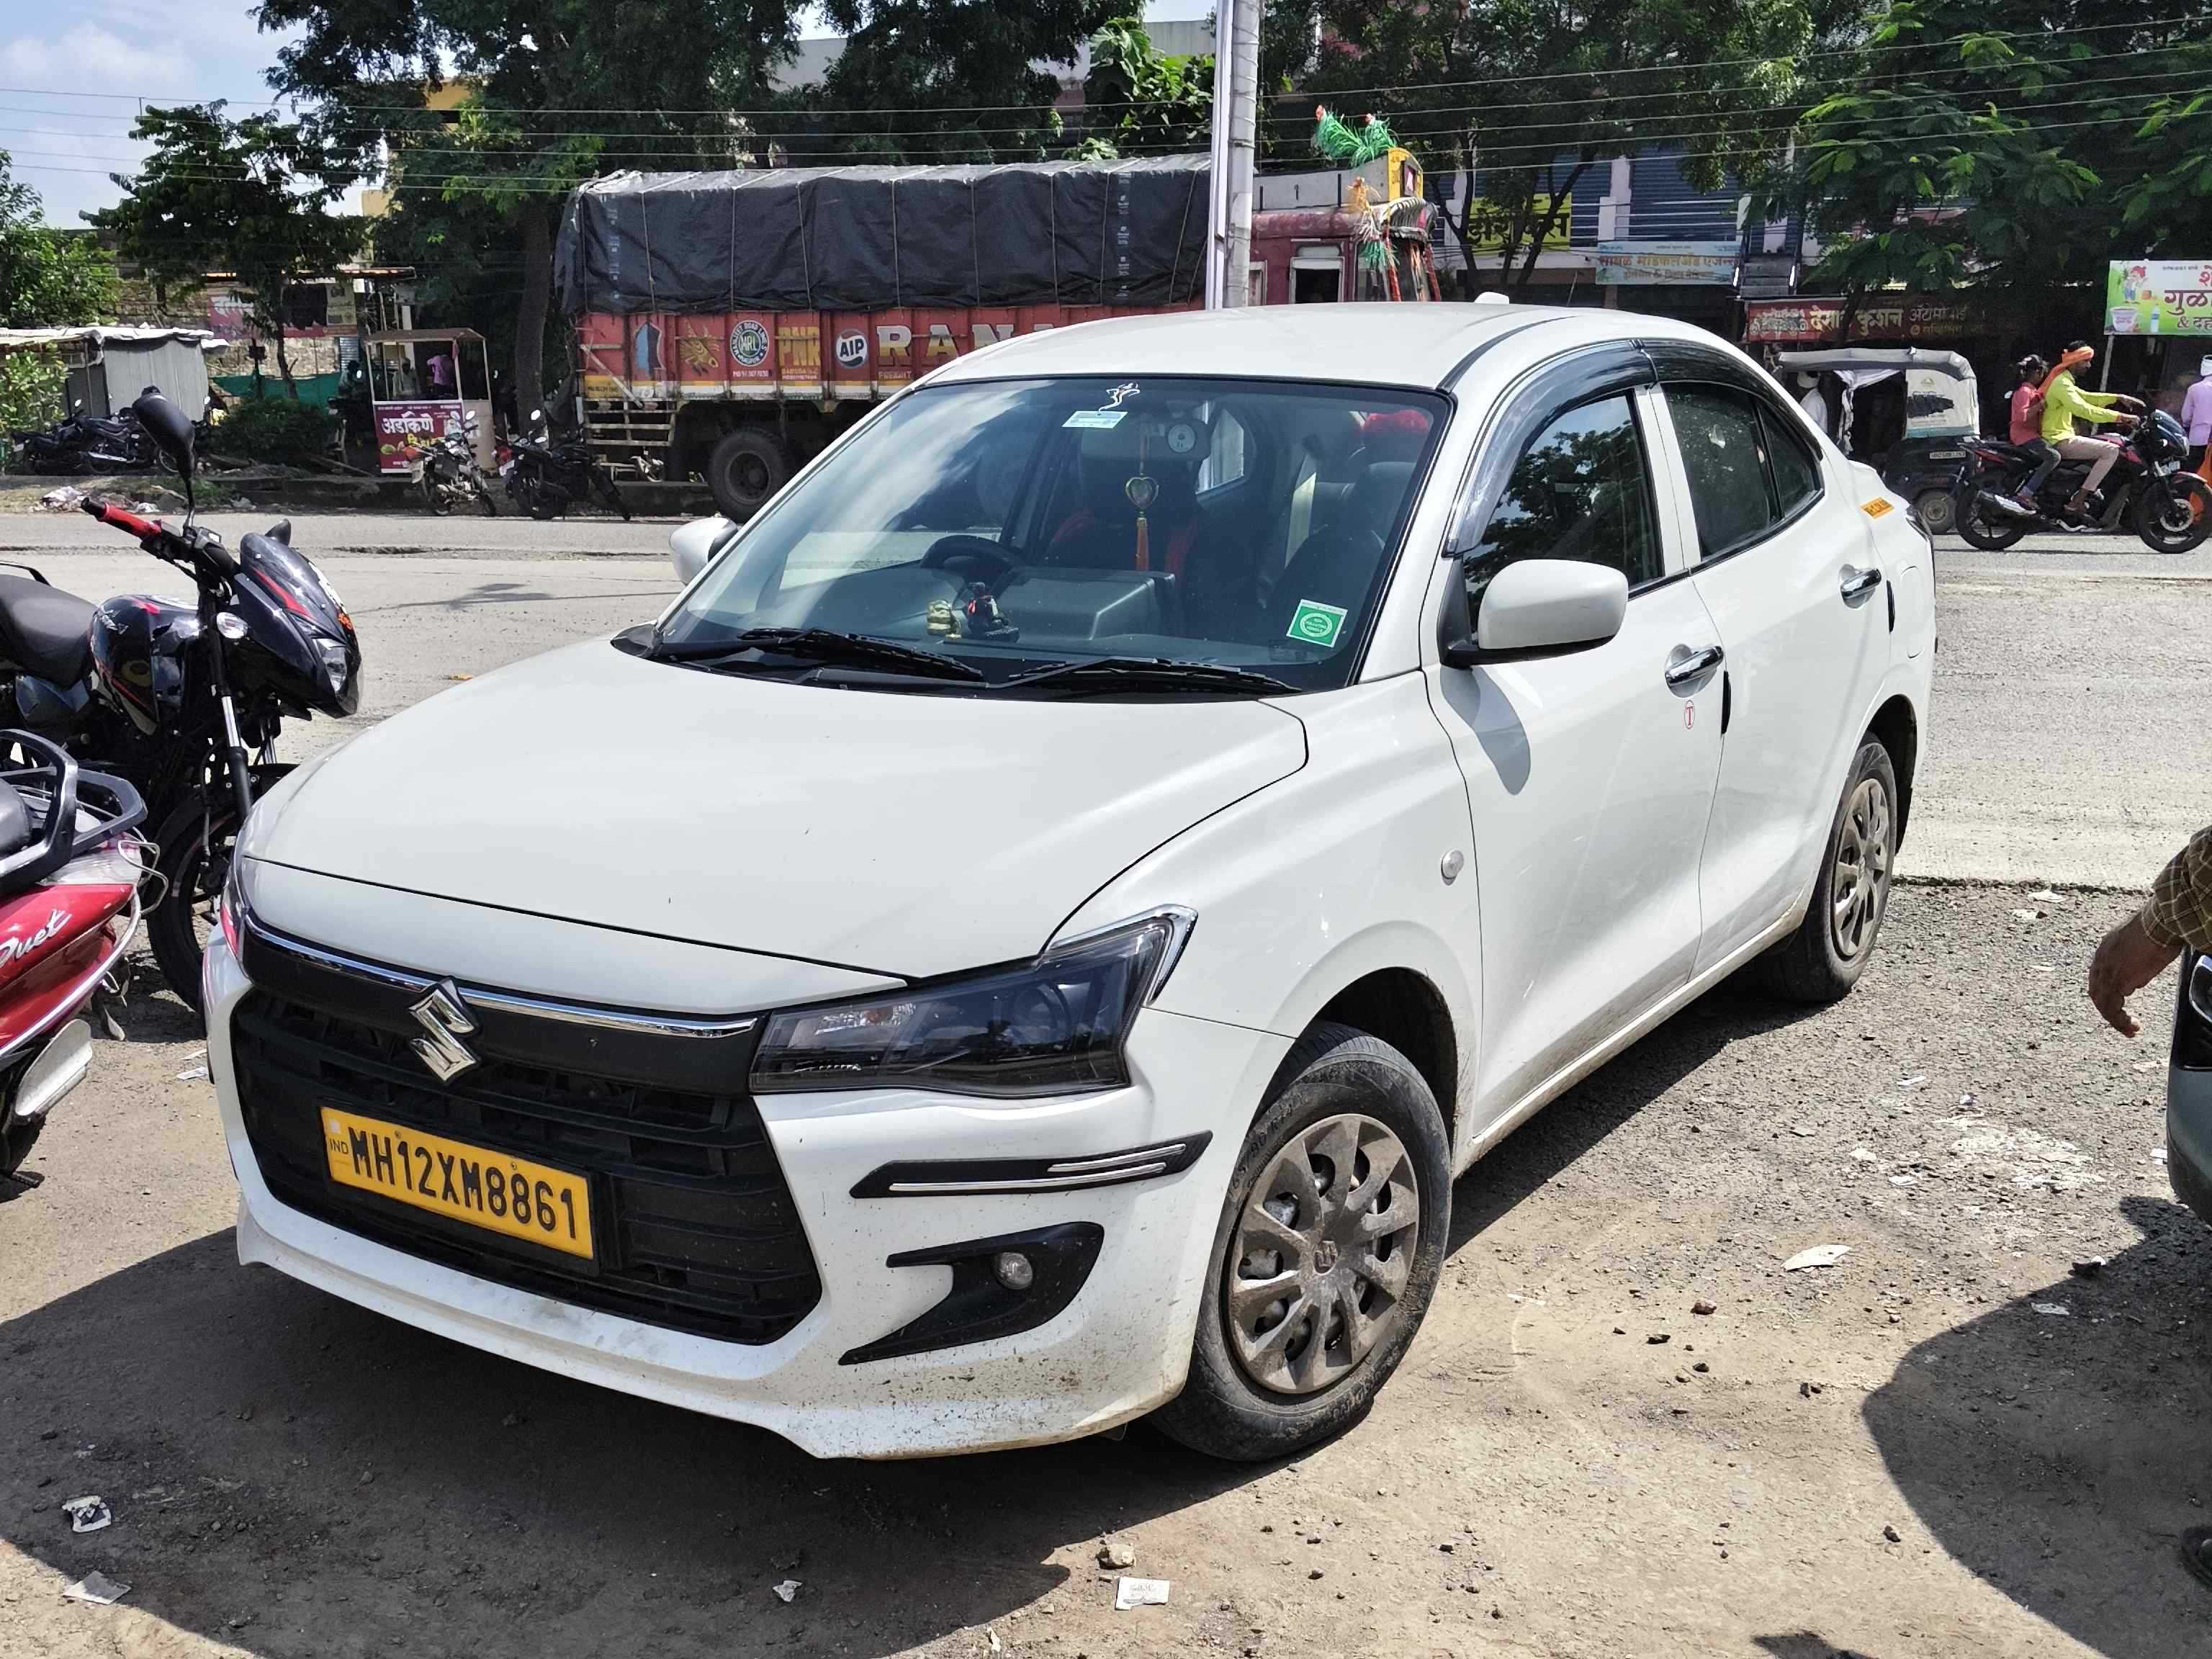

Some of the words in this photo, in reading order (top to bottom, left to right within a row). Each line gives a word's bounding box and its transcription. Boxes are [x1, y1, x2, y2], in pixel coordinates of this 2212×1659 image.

[840, 336, 865, 358] AIP
[876, 324, 1055, 365] RAN
[329, 1138, 349, 1155] IND
[348, 1126, 577, 1240] MH12XM8861
